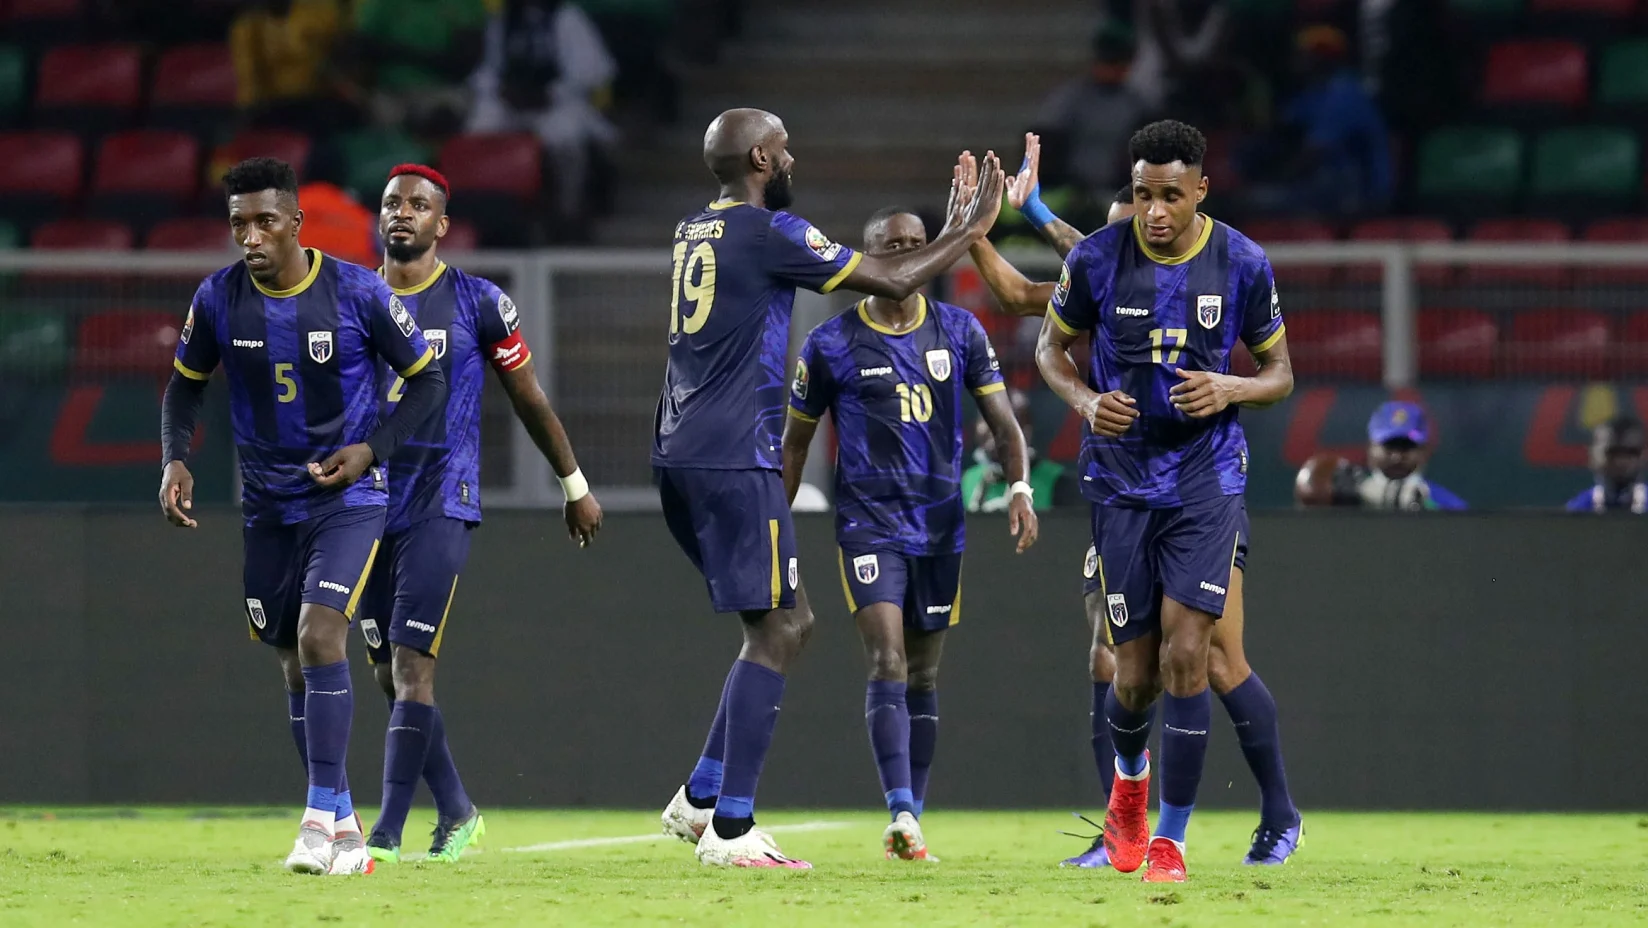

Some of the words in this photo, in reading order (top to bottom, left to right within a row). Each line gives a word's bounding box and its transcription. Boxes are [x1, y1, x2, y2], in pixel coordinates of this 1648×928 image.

[670, 241, 716, 335] 19
[1116, 306, 1149, 317] tempo
[232, 338, 264, 348] tempo
[1148, 328, 1188, 364] 17
[860, 366, 893, 377] tempo
[274, 363, 297, 403] 5
[896, 382, 933, 423] 10
[319, 579, 350, 595] tempo
[1200, 580, 1226, 595] tempo
[406, 619, 435, 633] tempo
